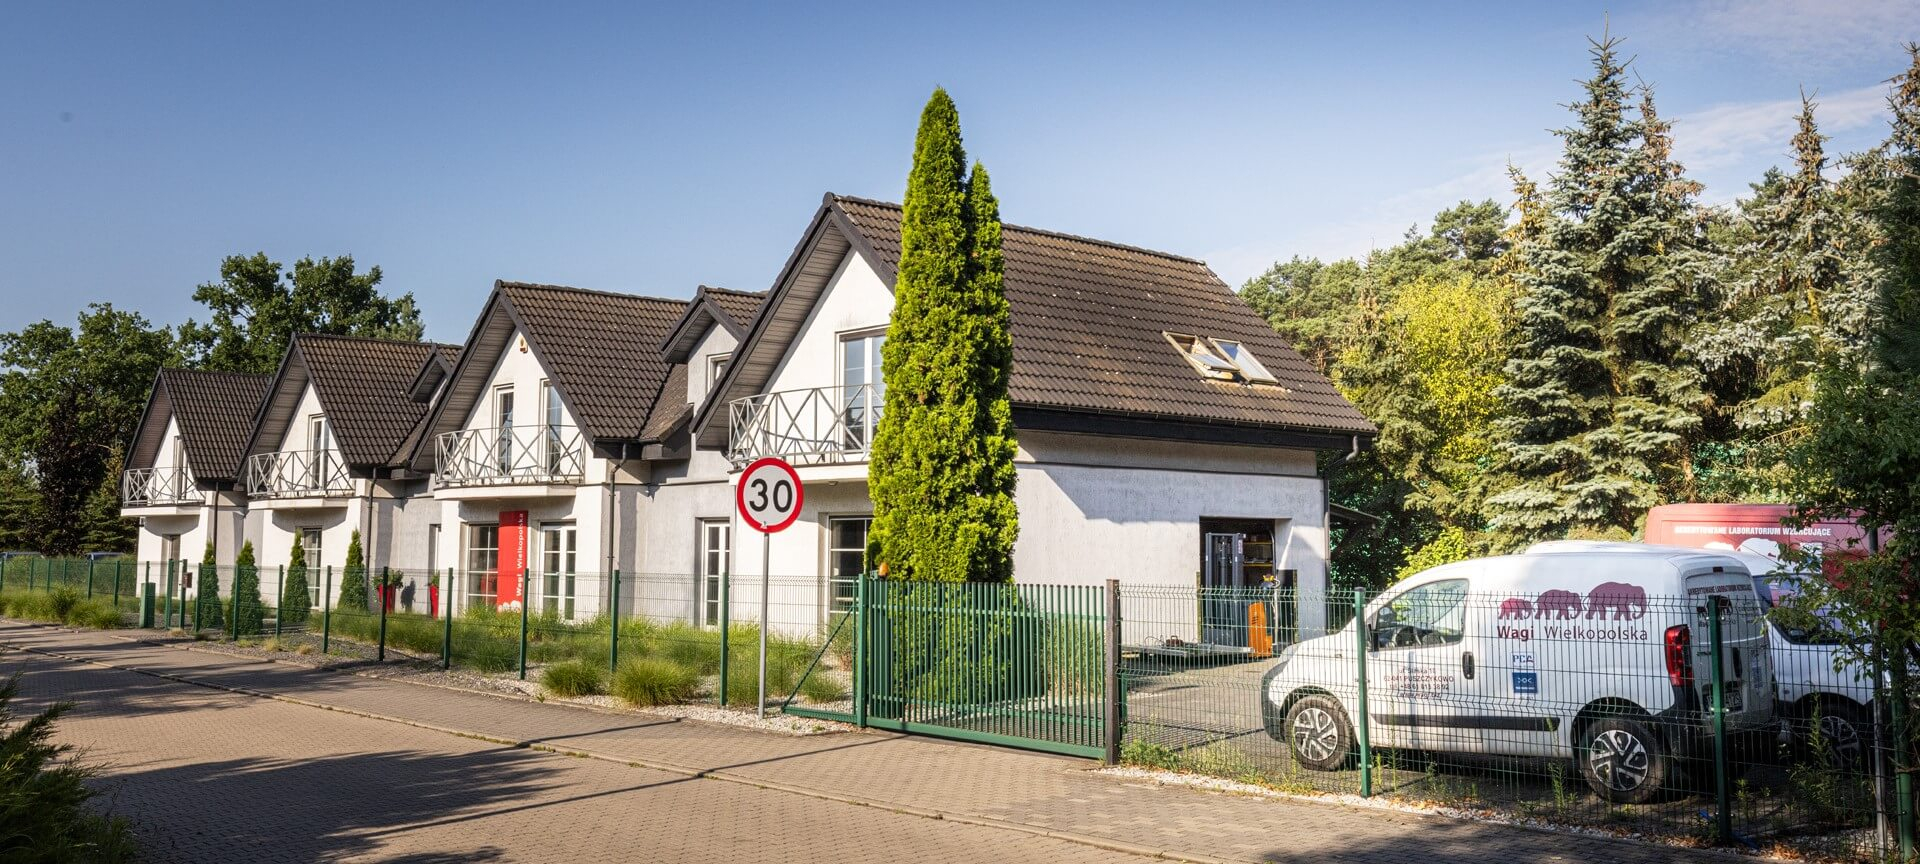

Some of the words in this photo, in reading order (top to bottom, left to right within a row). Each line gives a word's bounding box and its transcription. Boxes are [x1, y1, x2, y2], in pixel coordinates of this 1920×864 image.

[749, 478, 793, 513] 30
[1728, 527, 1781, 535] LABORATORIUM
[516, 574, 524, 596] Wagi
[1497, 625, 1534, 642] Wagi
[1544, 625, 1648, 643] Wielkopolska
[1512, 654, 1535, 663] PCA
